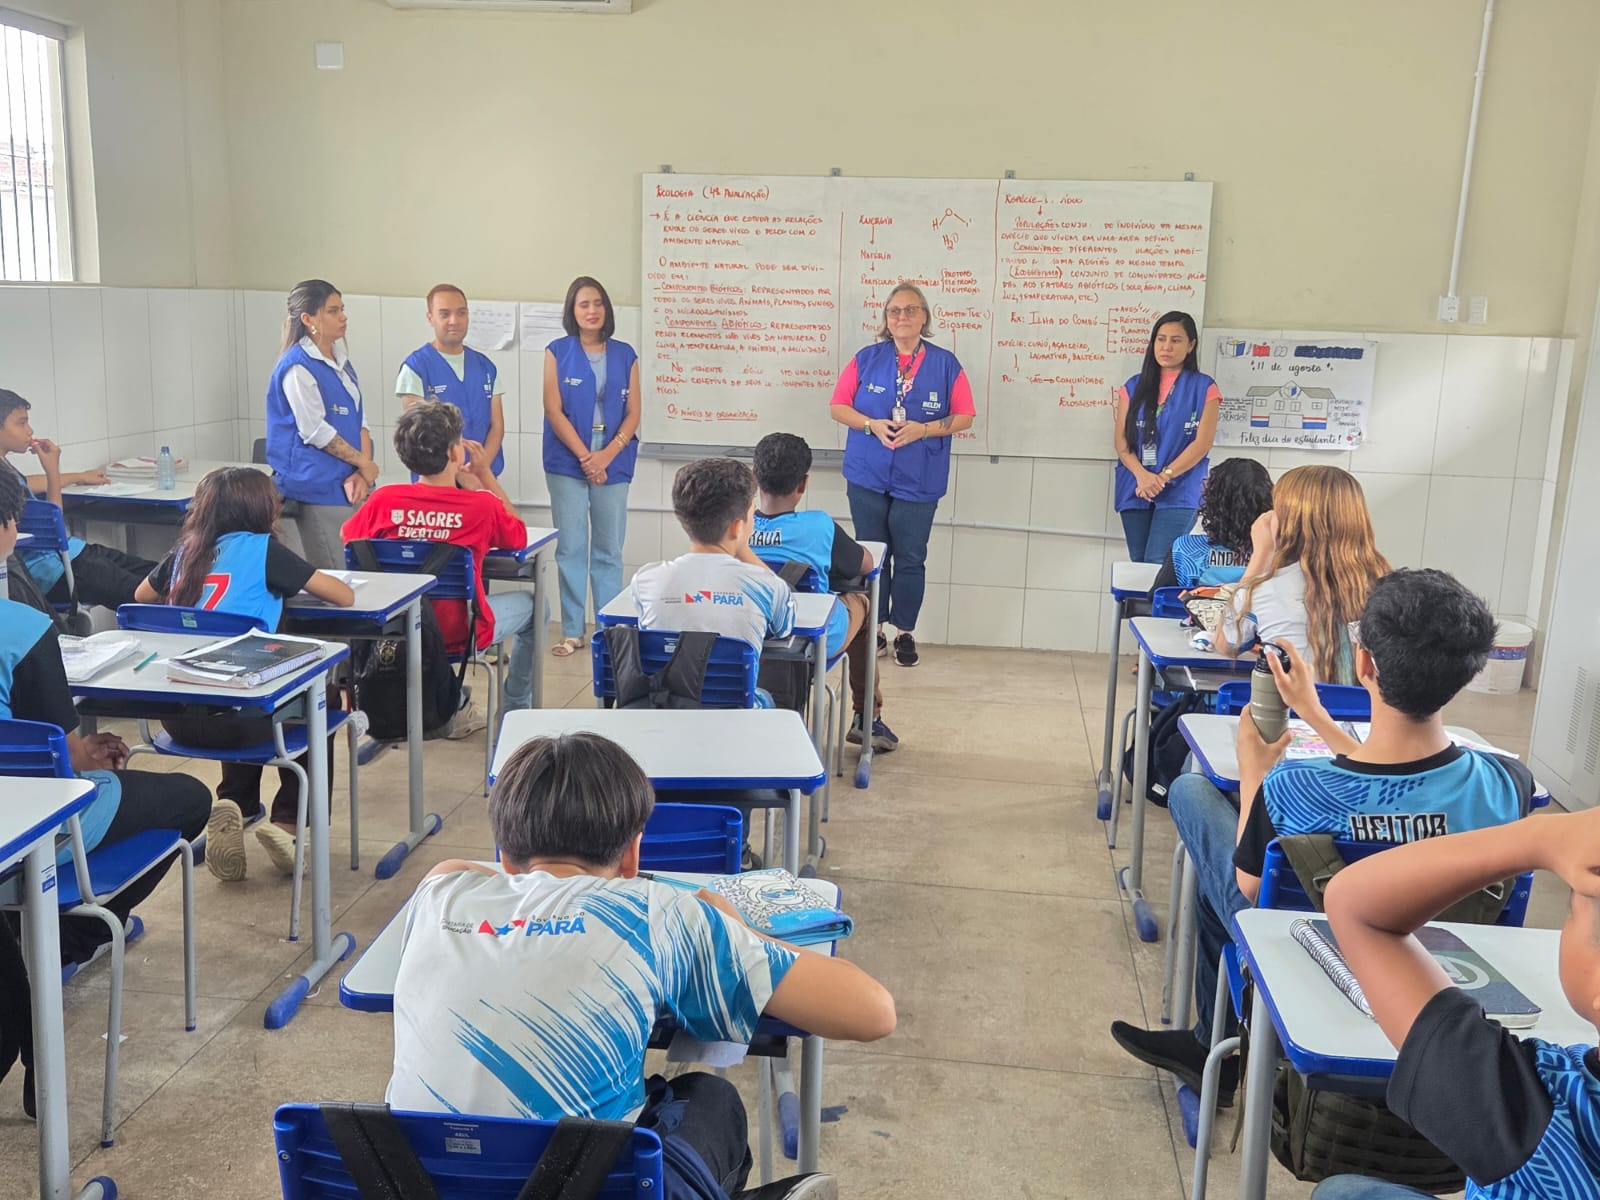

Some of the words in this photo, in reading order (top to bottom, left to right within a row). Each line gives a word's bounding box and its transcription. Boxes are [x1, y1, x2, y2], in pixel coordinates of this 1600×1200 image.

[407, 510, 463, 528] SAGRES
[201, 572, 232, 611] 7
[1350, 813, 1449, 844] HEITOR
